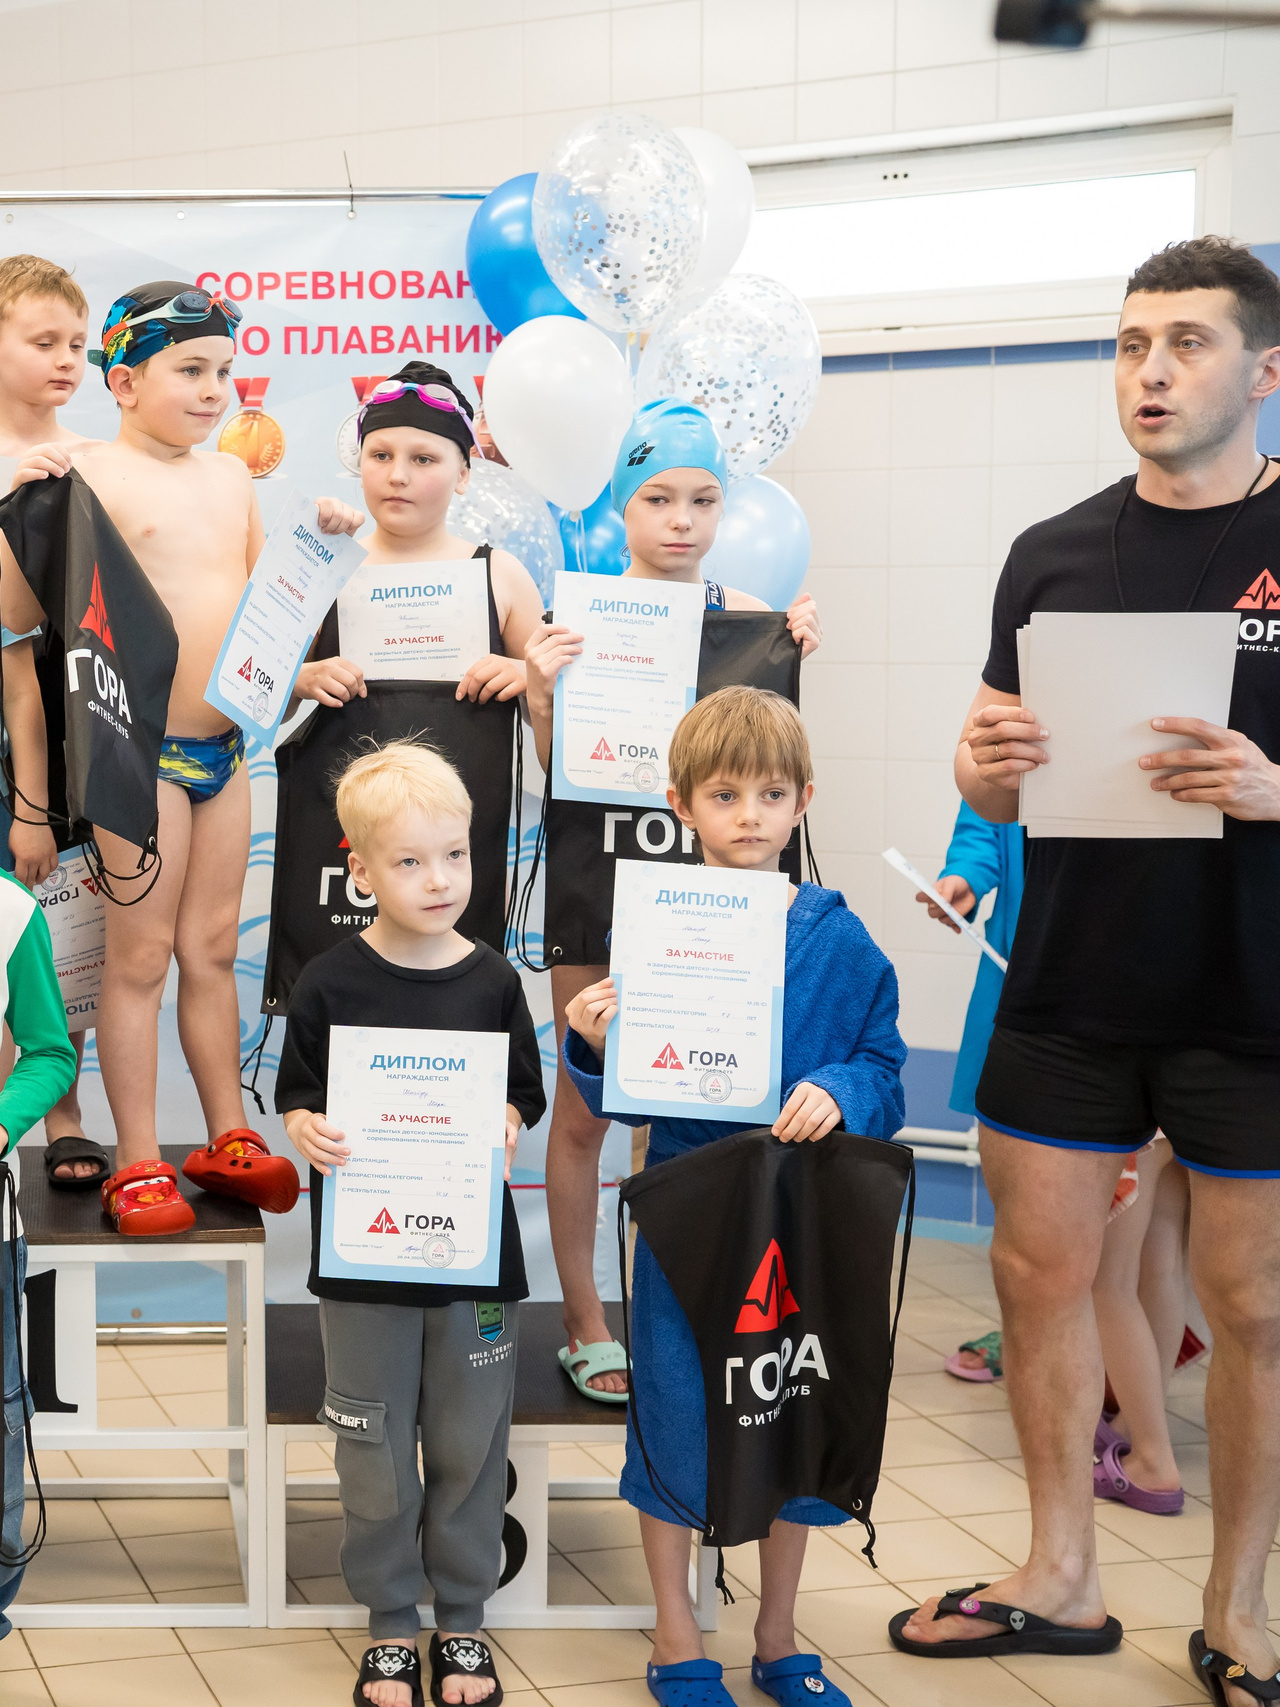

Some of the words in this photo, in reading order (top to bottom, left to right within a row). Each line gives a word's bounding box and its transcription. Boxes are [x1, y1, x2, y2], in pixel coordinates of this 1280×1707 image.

[195, 270, 476, 300] СОРЕВНОВАН
[293, 524, 335, 565] ДИПЛОМ
[277, 575, 286, 584] ЗА
[283, 580, 306, 603] УЧАСТИЕ
[370, 584, 452, 602] ДИПЛОМ
[709, 582, 720, 606] FILA
[385, 601, 439, 609] НАГРАЖДАЕТСЯ
[589, 598, 669, 618] ДИПЛОМ
[602, 616, 655, 626] НАГРАЖДАЕТСЯ
[1239, 618, 1280, 641] ОР
[399, 635, 445, 645] УЧАСТИЕ
[596, 652, 610, 660] ЗА
[611, 654, 655, 665] УЧАСТИЕ
[66, 648, 132, 724] ГОРА
[253, 667, 275, 693] ГОРА
[619, 744, 659, 760] ГОРА
[319, 866, 377, 908] ГО
[38, 887, 79, 909] ГОРА
[655, 889, 748, 910] ДИПЛОМ
[672, 909, 733, 919] НАГРАЖДАЕТСЯ
[665, 948, 681, 958] ЗА
[683, 950, 735, 962] УЧАСТИЕ
[370, 1054, 466, 1072] ДИПЛОМ
[688, 1050, 738, 1068] ГОРА
[386, 1074, 449, 1082] НАГРАЖДАЕТСЯ
[381, 1113, 396, 1122] ЗА
[399, 1114, 451, 1124] УЧАСТИЕ
[347, 1172, 388, 1180] ВОЗРАСТНОЙ
[404, 1214, 455, 1231] ГОРА
[726, 1333, 830, 1405] ГОРА
